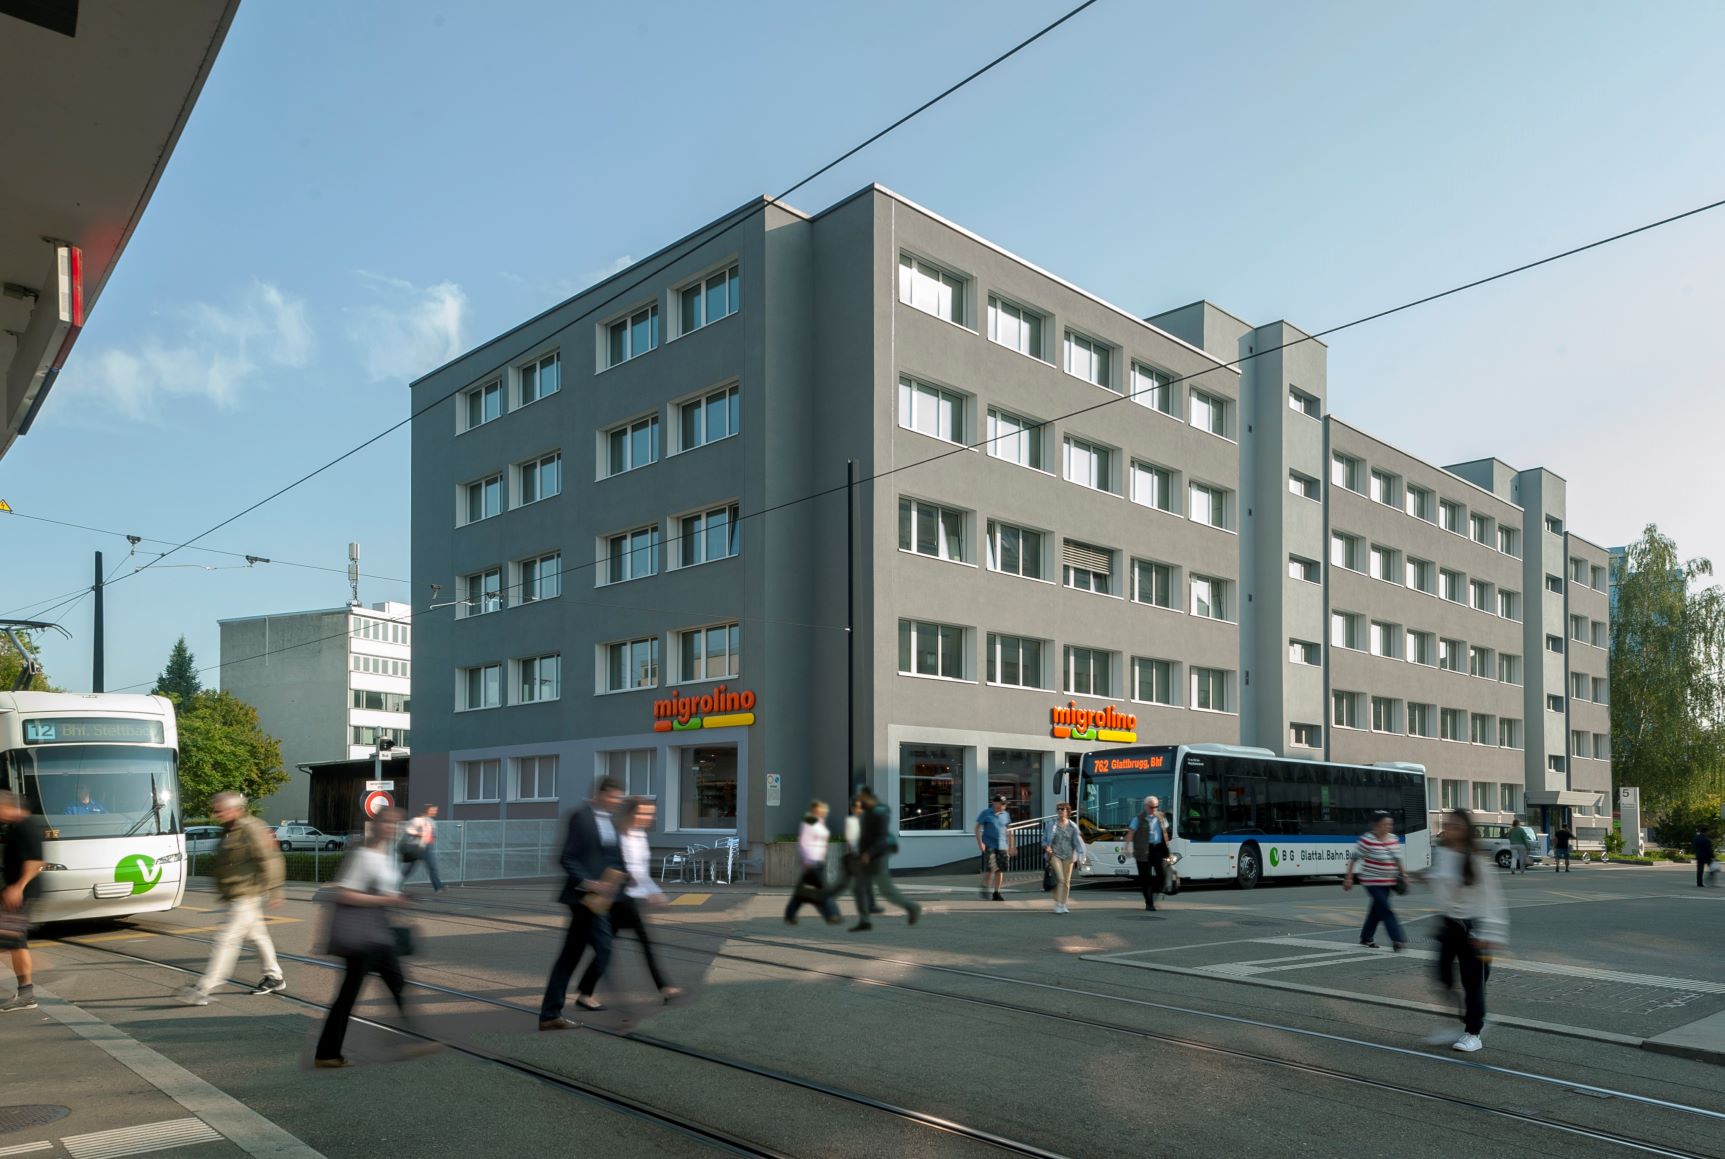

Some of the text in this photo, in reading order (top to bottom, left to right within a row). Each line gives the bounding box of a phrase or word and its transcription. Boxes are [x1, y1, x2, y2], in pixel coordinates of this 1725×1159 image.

[653, 684, 755, 724] migrolino
[1053, 699, 1136, 733] migrolino
[31, 723, 53, 737] 12
[1094, 755, 1164, 773] 762 Glattbrugg, Bhf
[1622, 788, 1630, 798] 5
[1300, 849, 1354, 861] Glattal.Bahn.Bu
